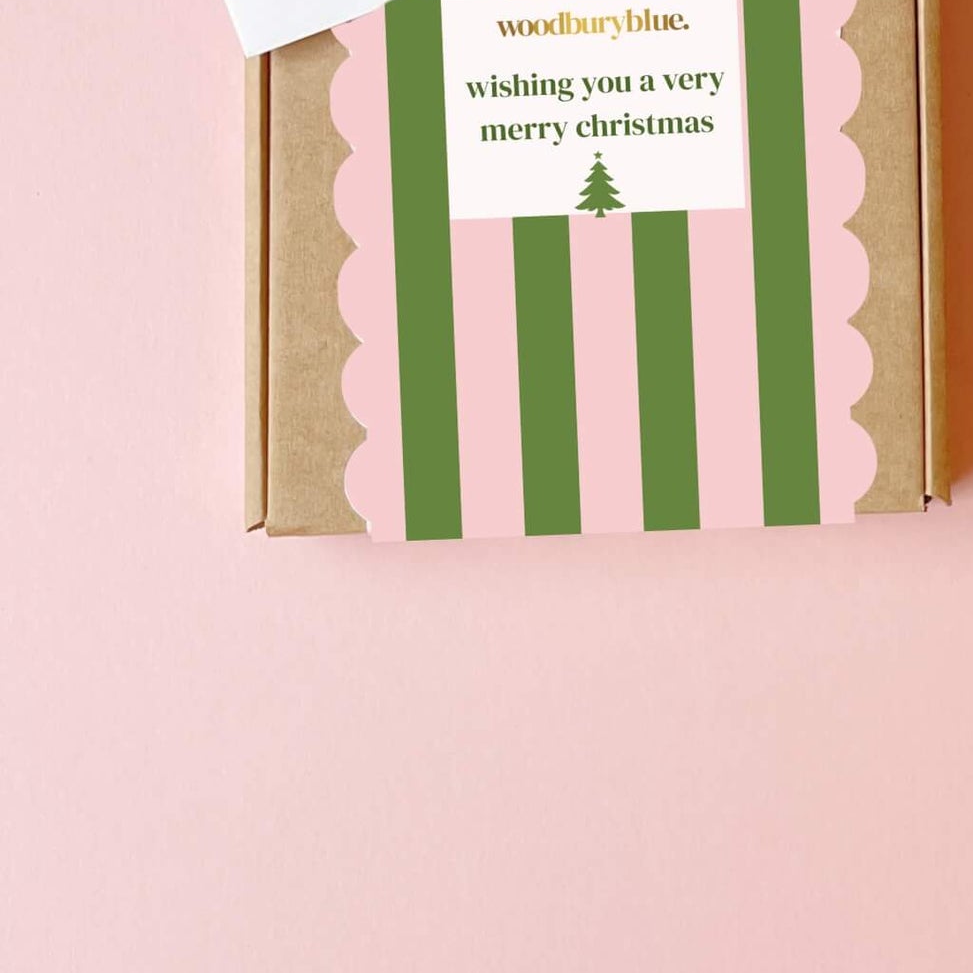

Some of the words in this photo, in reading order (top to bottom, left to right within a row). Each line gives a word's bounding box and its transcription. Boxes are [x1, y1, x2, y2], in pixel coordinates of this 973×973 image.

[496, 8, 690, 40] woodburyblue.
[466, 73, 574, 102] wishing
[581, 74, 632, 102] you
[639, 74, 656, 92] a
[662, 70, 725, 96] very
[480, 120, 568, 146] merry
[575, 112, 715, 138] christmas
